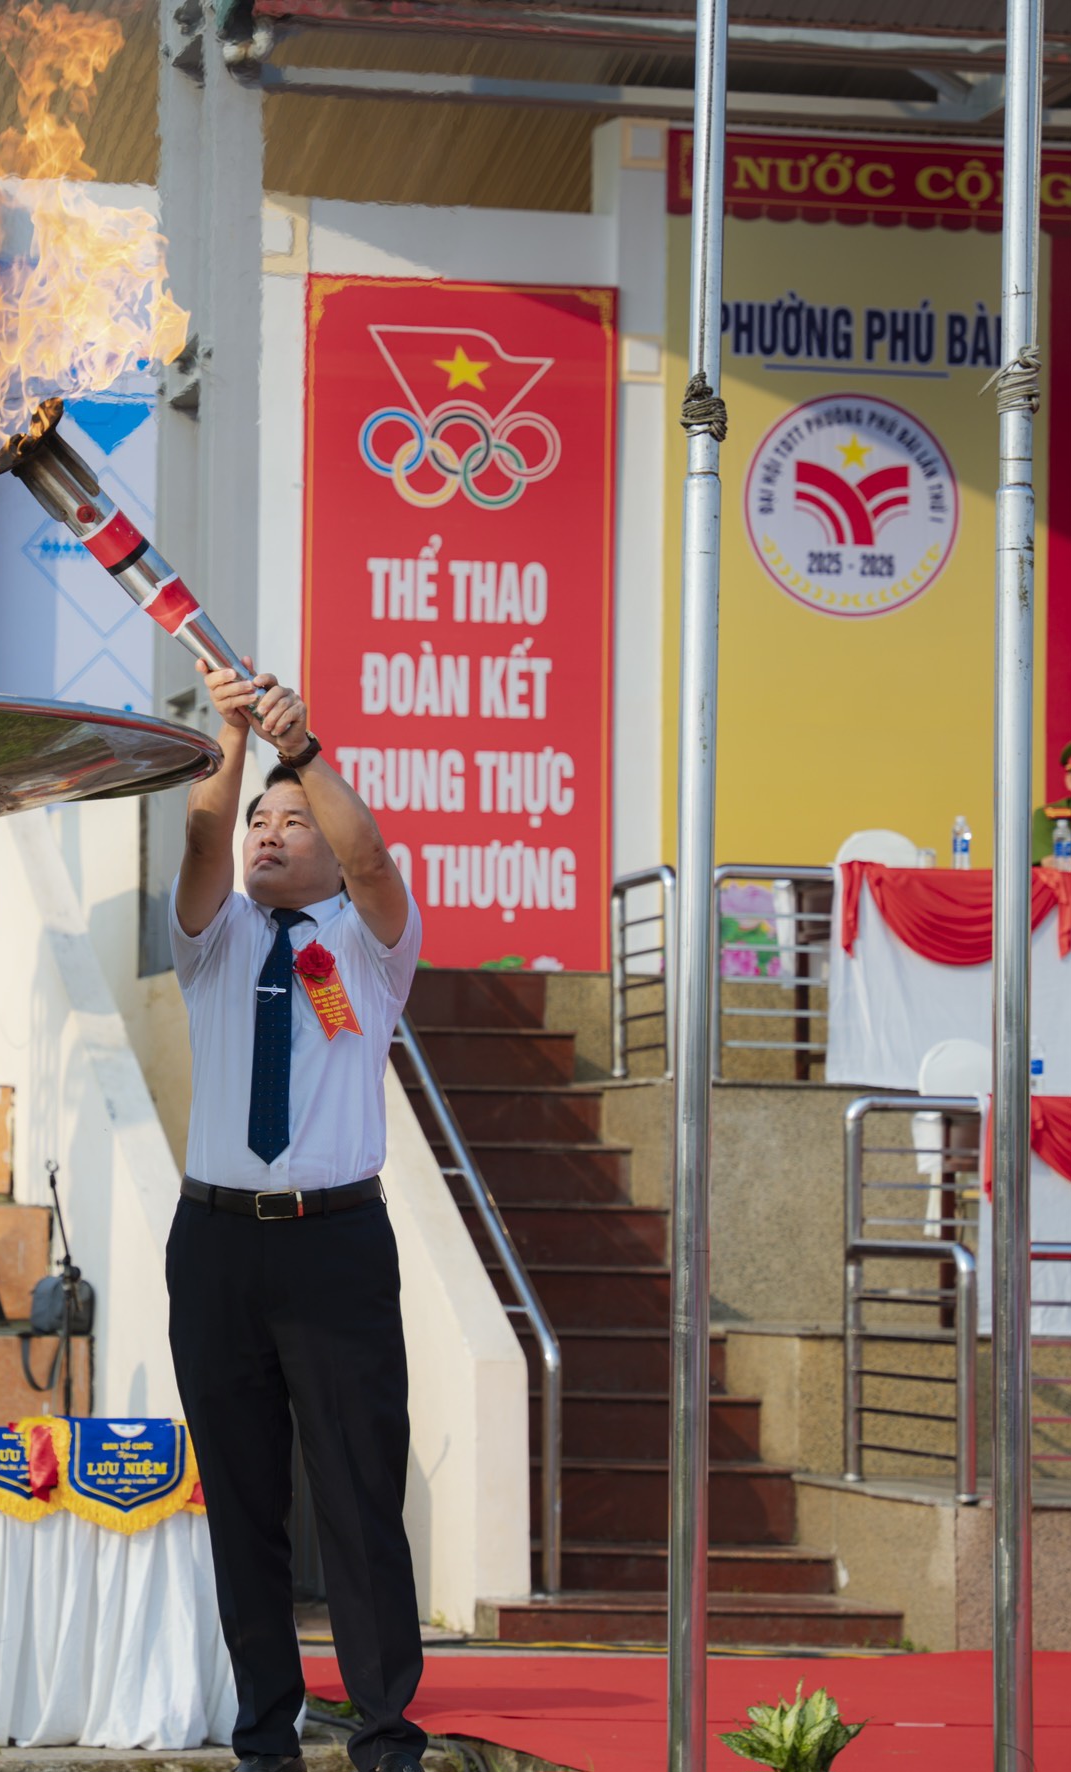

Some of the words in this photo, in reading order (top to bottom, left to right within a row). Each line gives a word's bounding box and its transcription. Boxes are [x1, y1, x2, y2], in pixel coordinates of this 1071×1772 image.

[733, 152, 896, 198] NƯỚC
[915, 159, 1071, 210] CỘG
[866, 301, 935, 364] PHÚ
[367, 534, 442, 620] THỂ
[448, 560, 548, 625] THAO
[808, 551, 842, 575] 2025
[860, 553, 895, 577] 2026
[361, 641, 470, 718] ĐOÀN
[480, 637, 552, 719] KẾT
[335, 746, 465, 813] TRUNG
[474, 746, 574, 828] THỰC
[421, 839, 577, 923] THƯỢNG
[86, 1461, 120, 1475] LƯU
[124, 1459, 168, 1477] NIỆM
